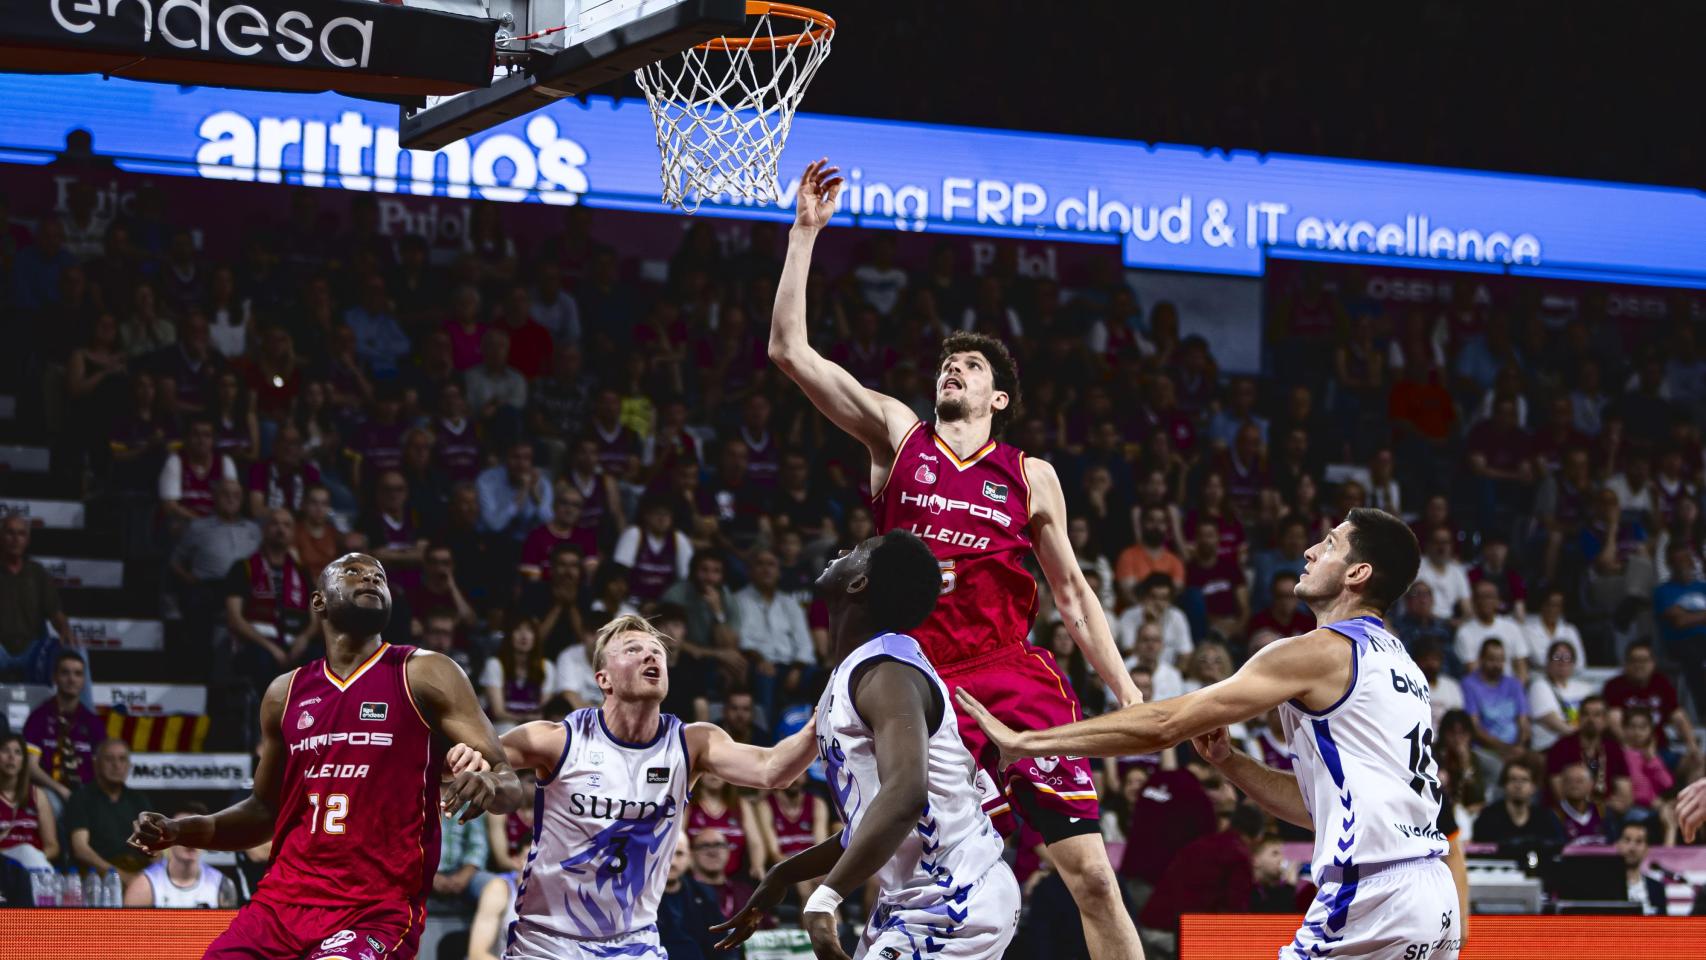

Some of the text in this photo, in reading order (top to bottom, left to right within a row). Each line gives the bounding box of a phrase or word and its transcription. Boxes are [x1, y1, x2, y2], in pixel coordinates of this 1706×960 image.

[51, 0, 375, 68] endesa
[1202, 198, 1235, 248] &
[1246, 201, 1289, 249] IT
[1295, 216, 1542, 267] excellence
[900, 491, 1012, 528] HIOPOS
[911, 523, 991, 550] LLEIDA
[290, 732, 393, 756] HIOPOS
[132, 762, 244, 780] McDonald's
[304, 764, 370, 780] LEIDA
[308, 793, 349, 835] 12
[569, 792, 677, 821] surne
[607, 836, 629, 874] 3
